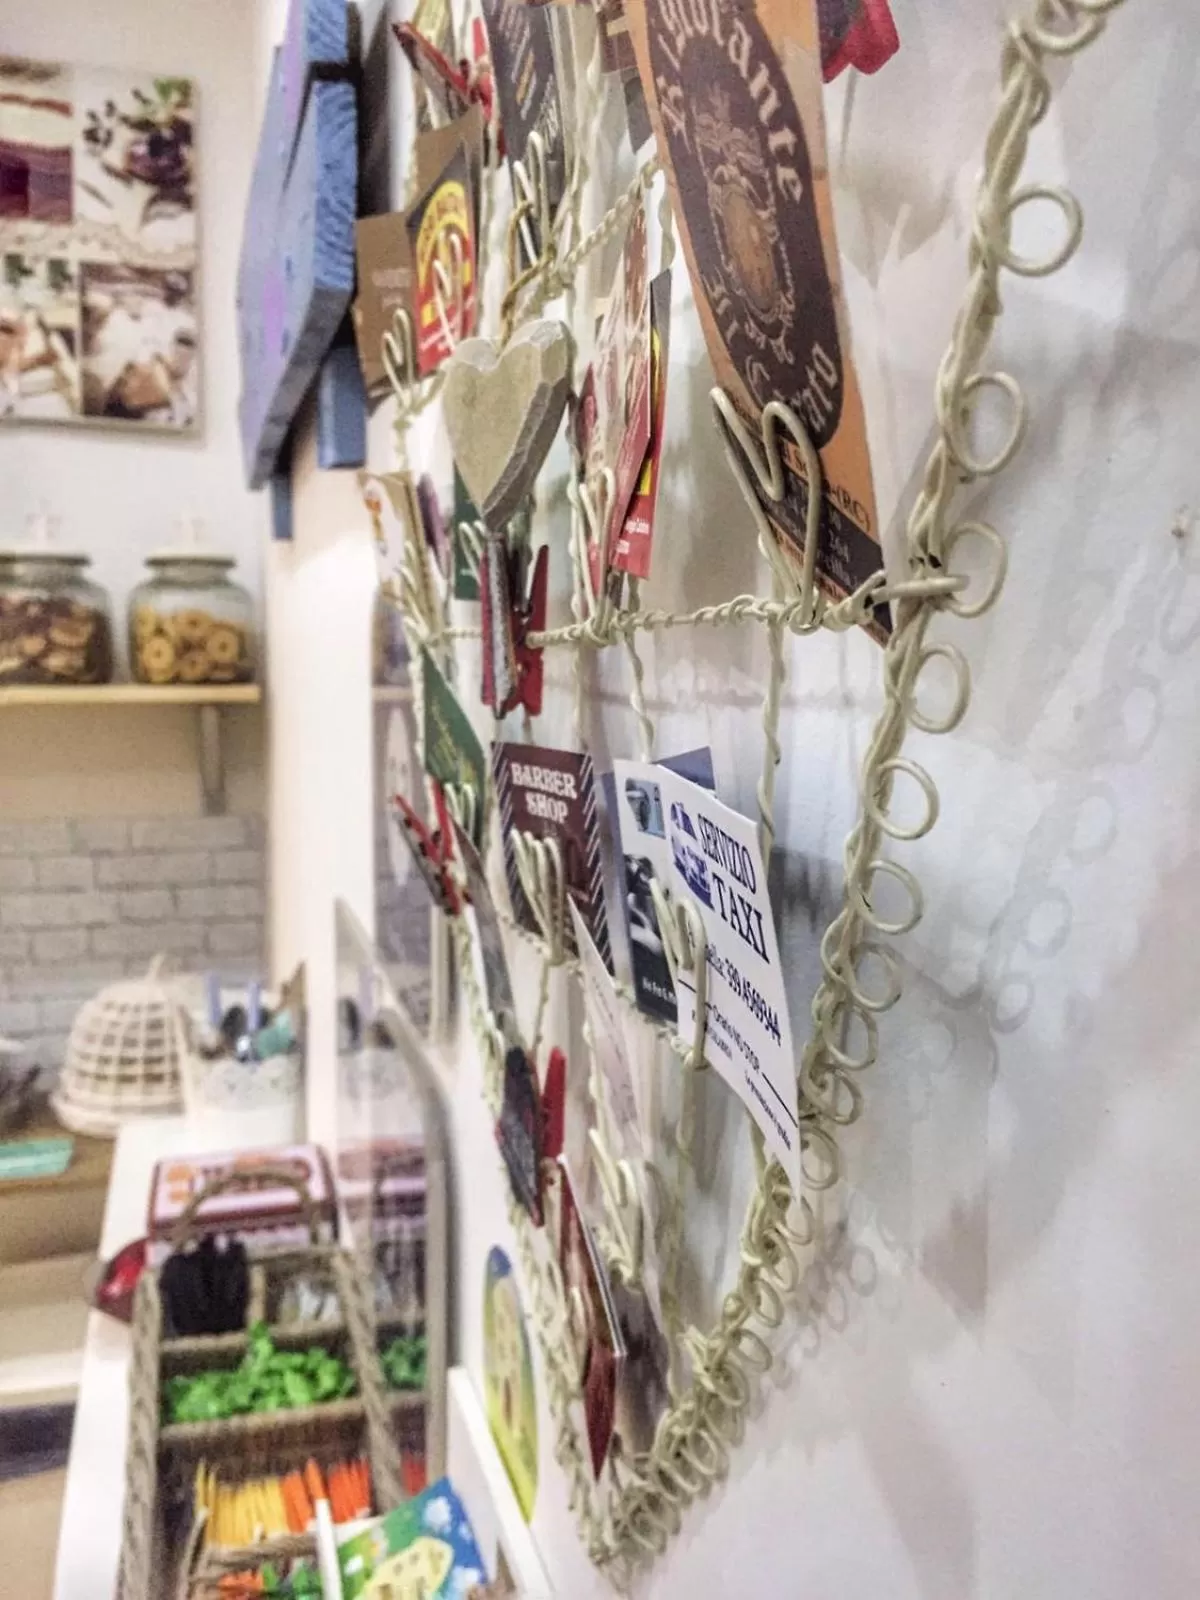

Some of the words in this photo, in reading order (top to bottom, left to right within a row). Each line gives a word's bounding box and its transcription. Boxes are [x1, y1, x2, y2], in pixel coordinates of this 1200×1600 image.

[510, 762, 578, 800] BARBER
[525, 791, 569, 824] SHOP
[698, 813, 757, 896] SERVIZIO
[712, 872, 770, 965] TAXI
